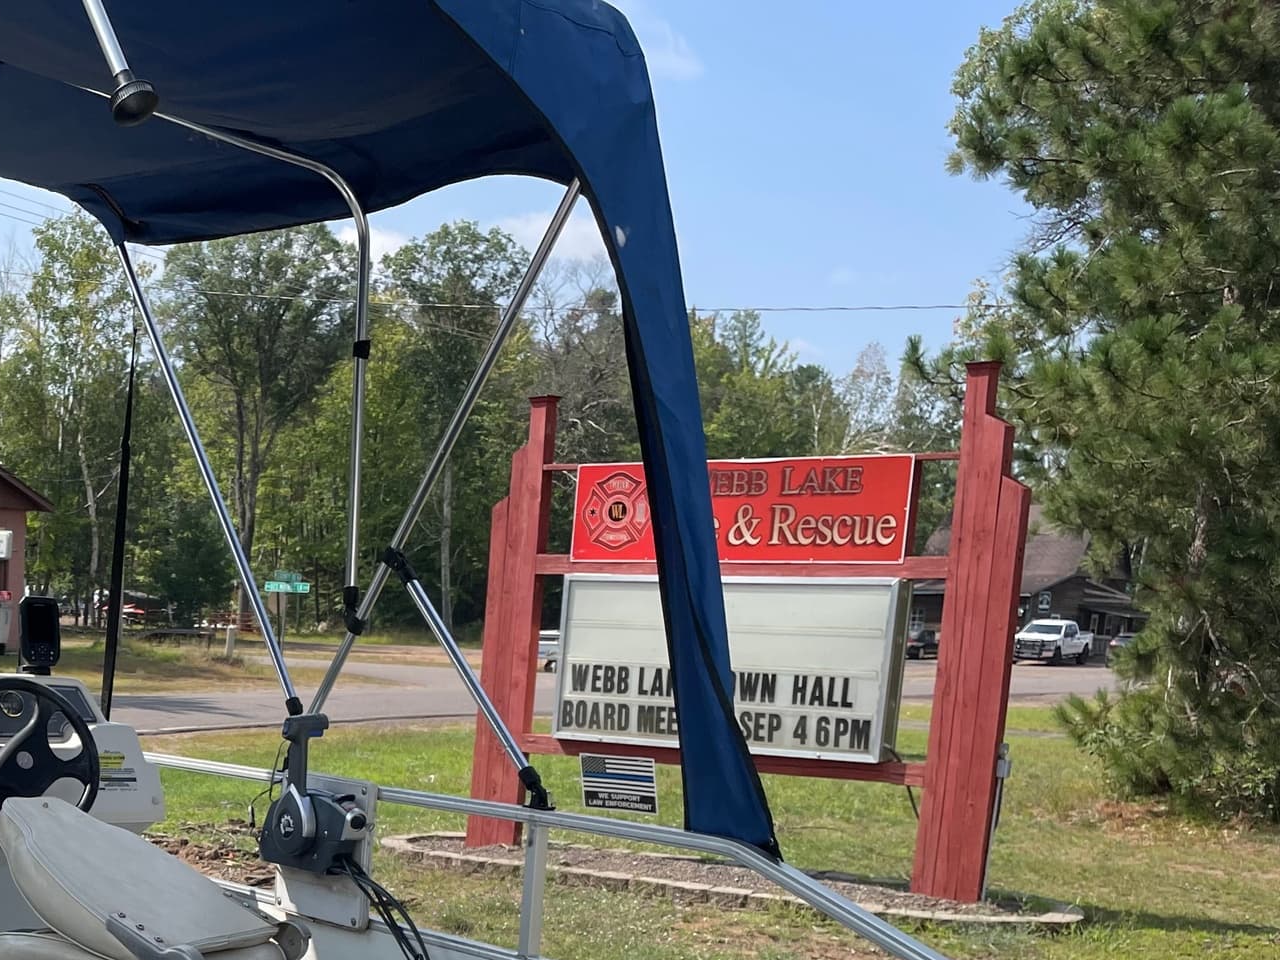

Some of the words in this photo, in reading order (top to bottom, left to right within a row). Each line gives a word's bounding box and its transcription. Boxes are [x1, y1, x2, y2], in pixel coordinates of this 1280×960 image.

[780, 466, 863, 496] LAKE
[727, 504, 761, 546] &
[768, 504, 897, 546] Rescue
[571, 663, 630, 695] WEBB
[791, 674, 853, 709] HALL
[561, 699, 630, 732] BOARD
[739, 711, 782, 743] SEP
[793, 715, 808, 745] 4
[815, 716, 871, 751] 6PM
[598, 792, 609, 800] WE
[611, 793, 640, 802] SUPPORT
[605, 800, 652, 811] ENFORCEMENT
